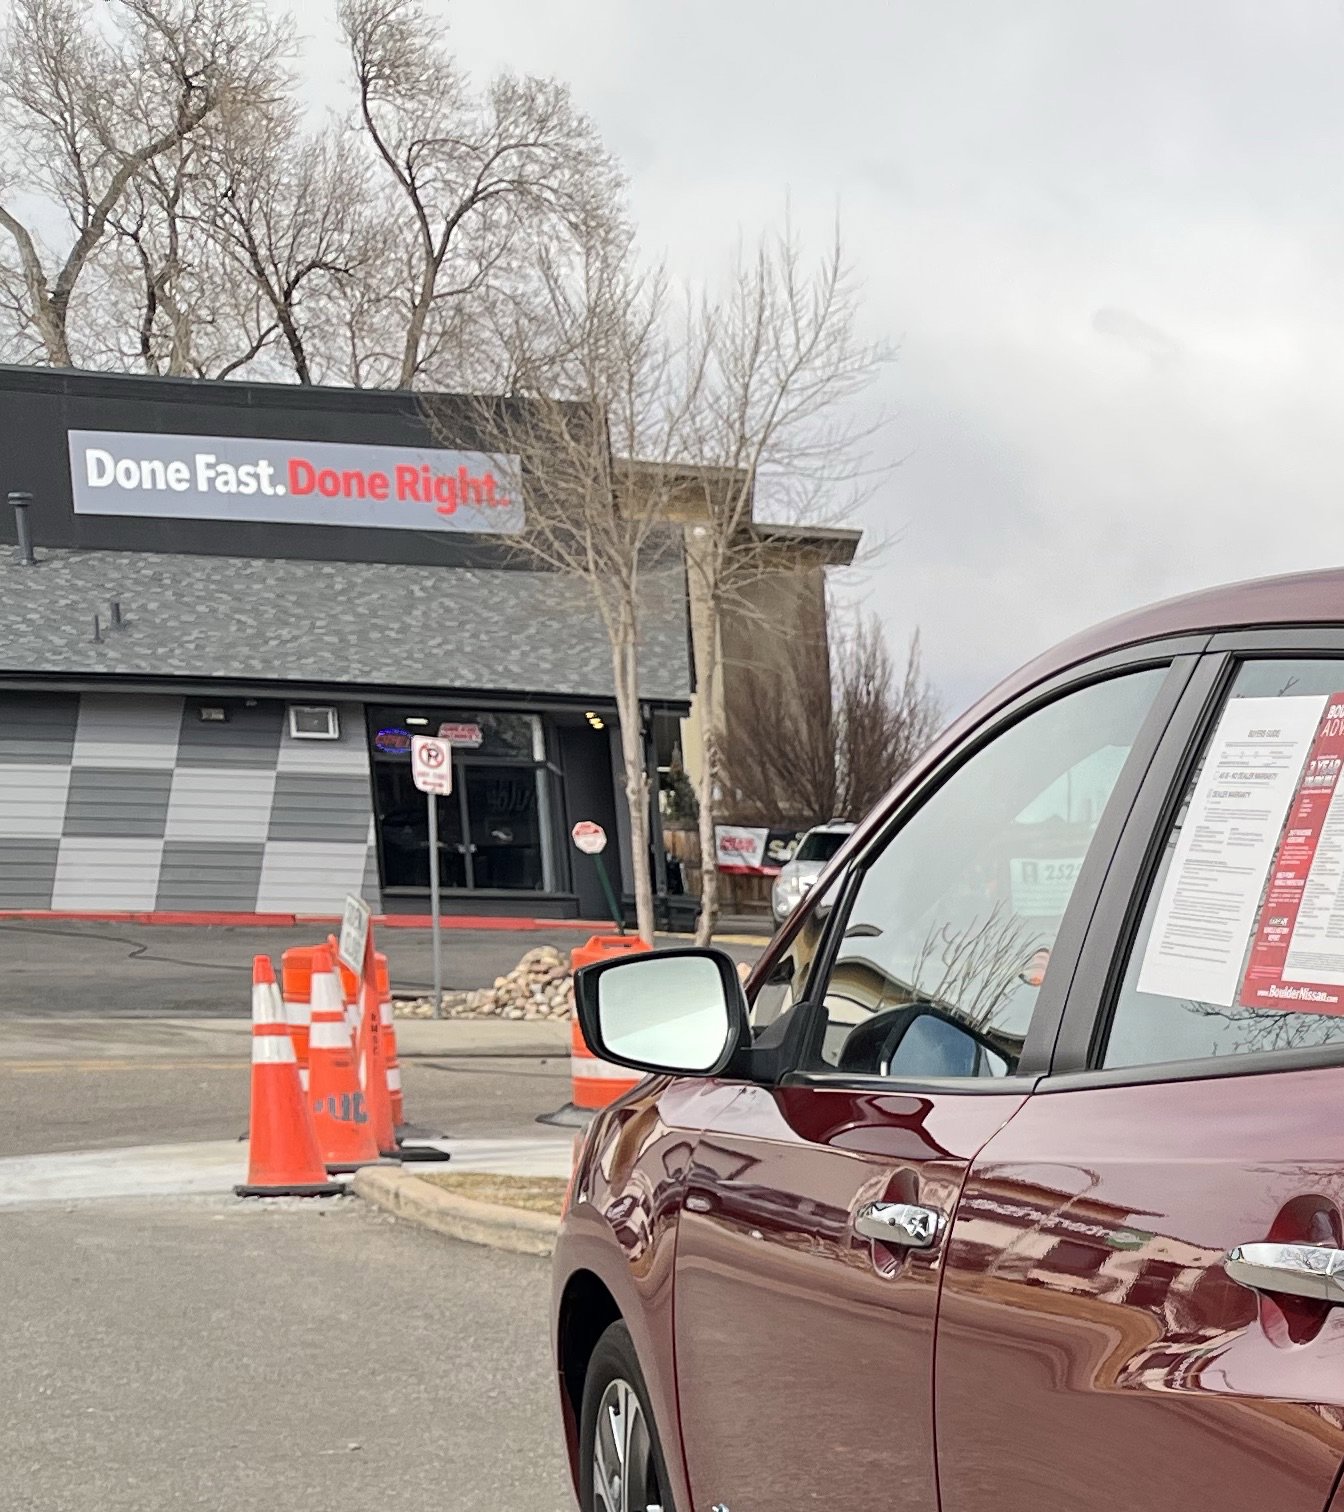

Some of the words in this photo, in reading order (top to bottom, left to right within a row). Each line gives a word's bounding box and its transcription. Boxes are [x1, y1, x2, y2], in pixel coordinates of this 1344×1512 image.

[85, 448, 190, 492] Done
[195, 453, 287, 496] Fast.
[288, 457, 390, 501] Done
[394, 463, 510, 515] Right.
